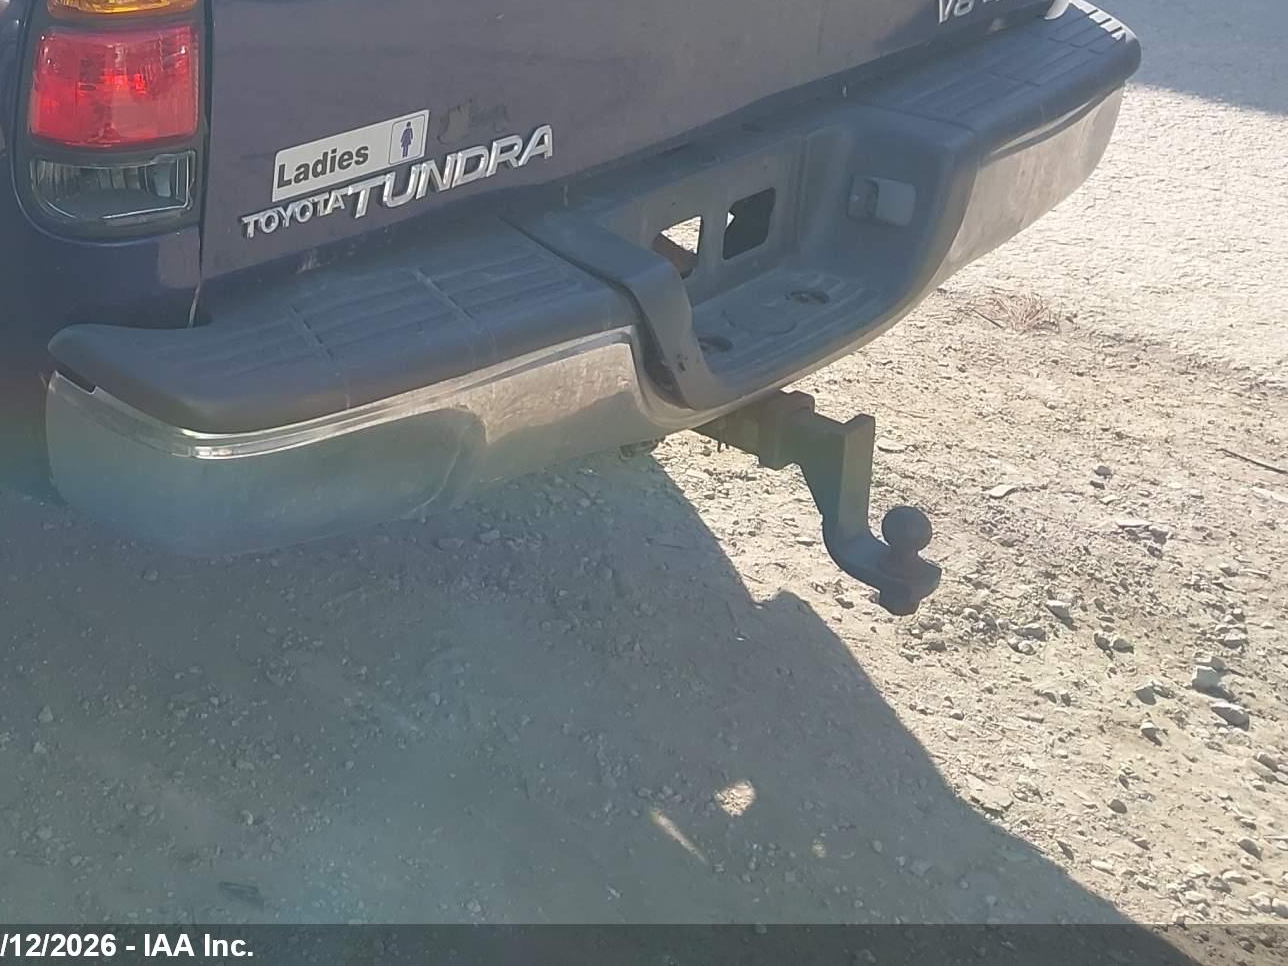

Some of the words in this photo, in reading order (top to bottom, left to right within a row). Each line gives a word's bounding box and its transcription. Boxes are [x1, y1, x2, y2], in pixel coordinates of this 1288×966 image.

[241, 190, 345, 238] TOYOTA
[346, 124, 554, 219] TUNDRA
[276, 144, 369, 189] Ladies
